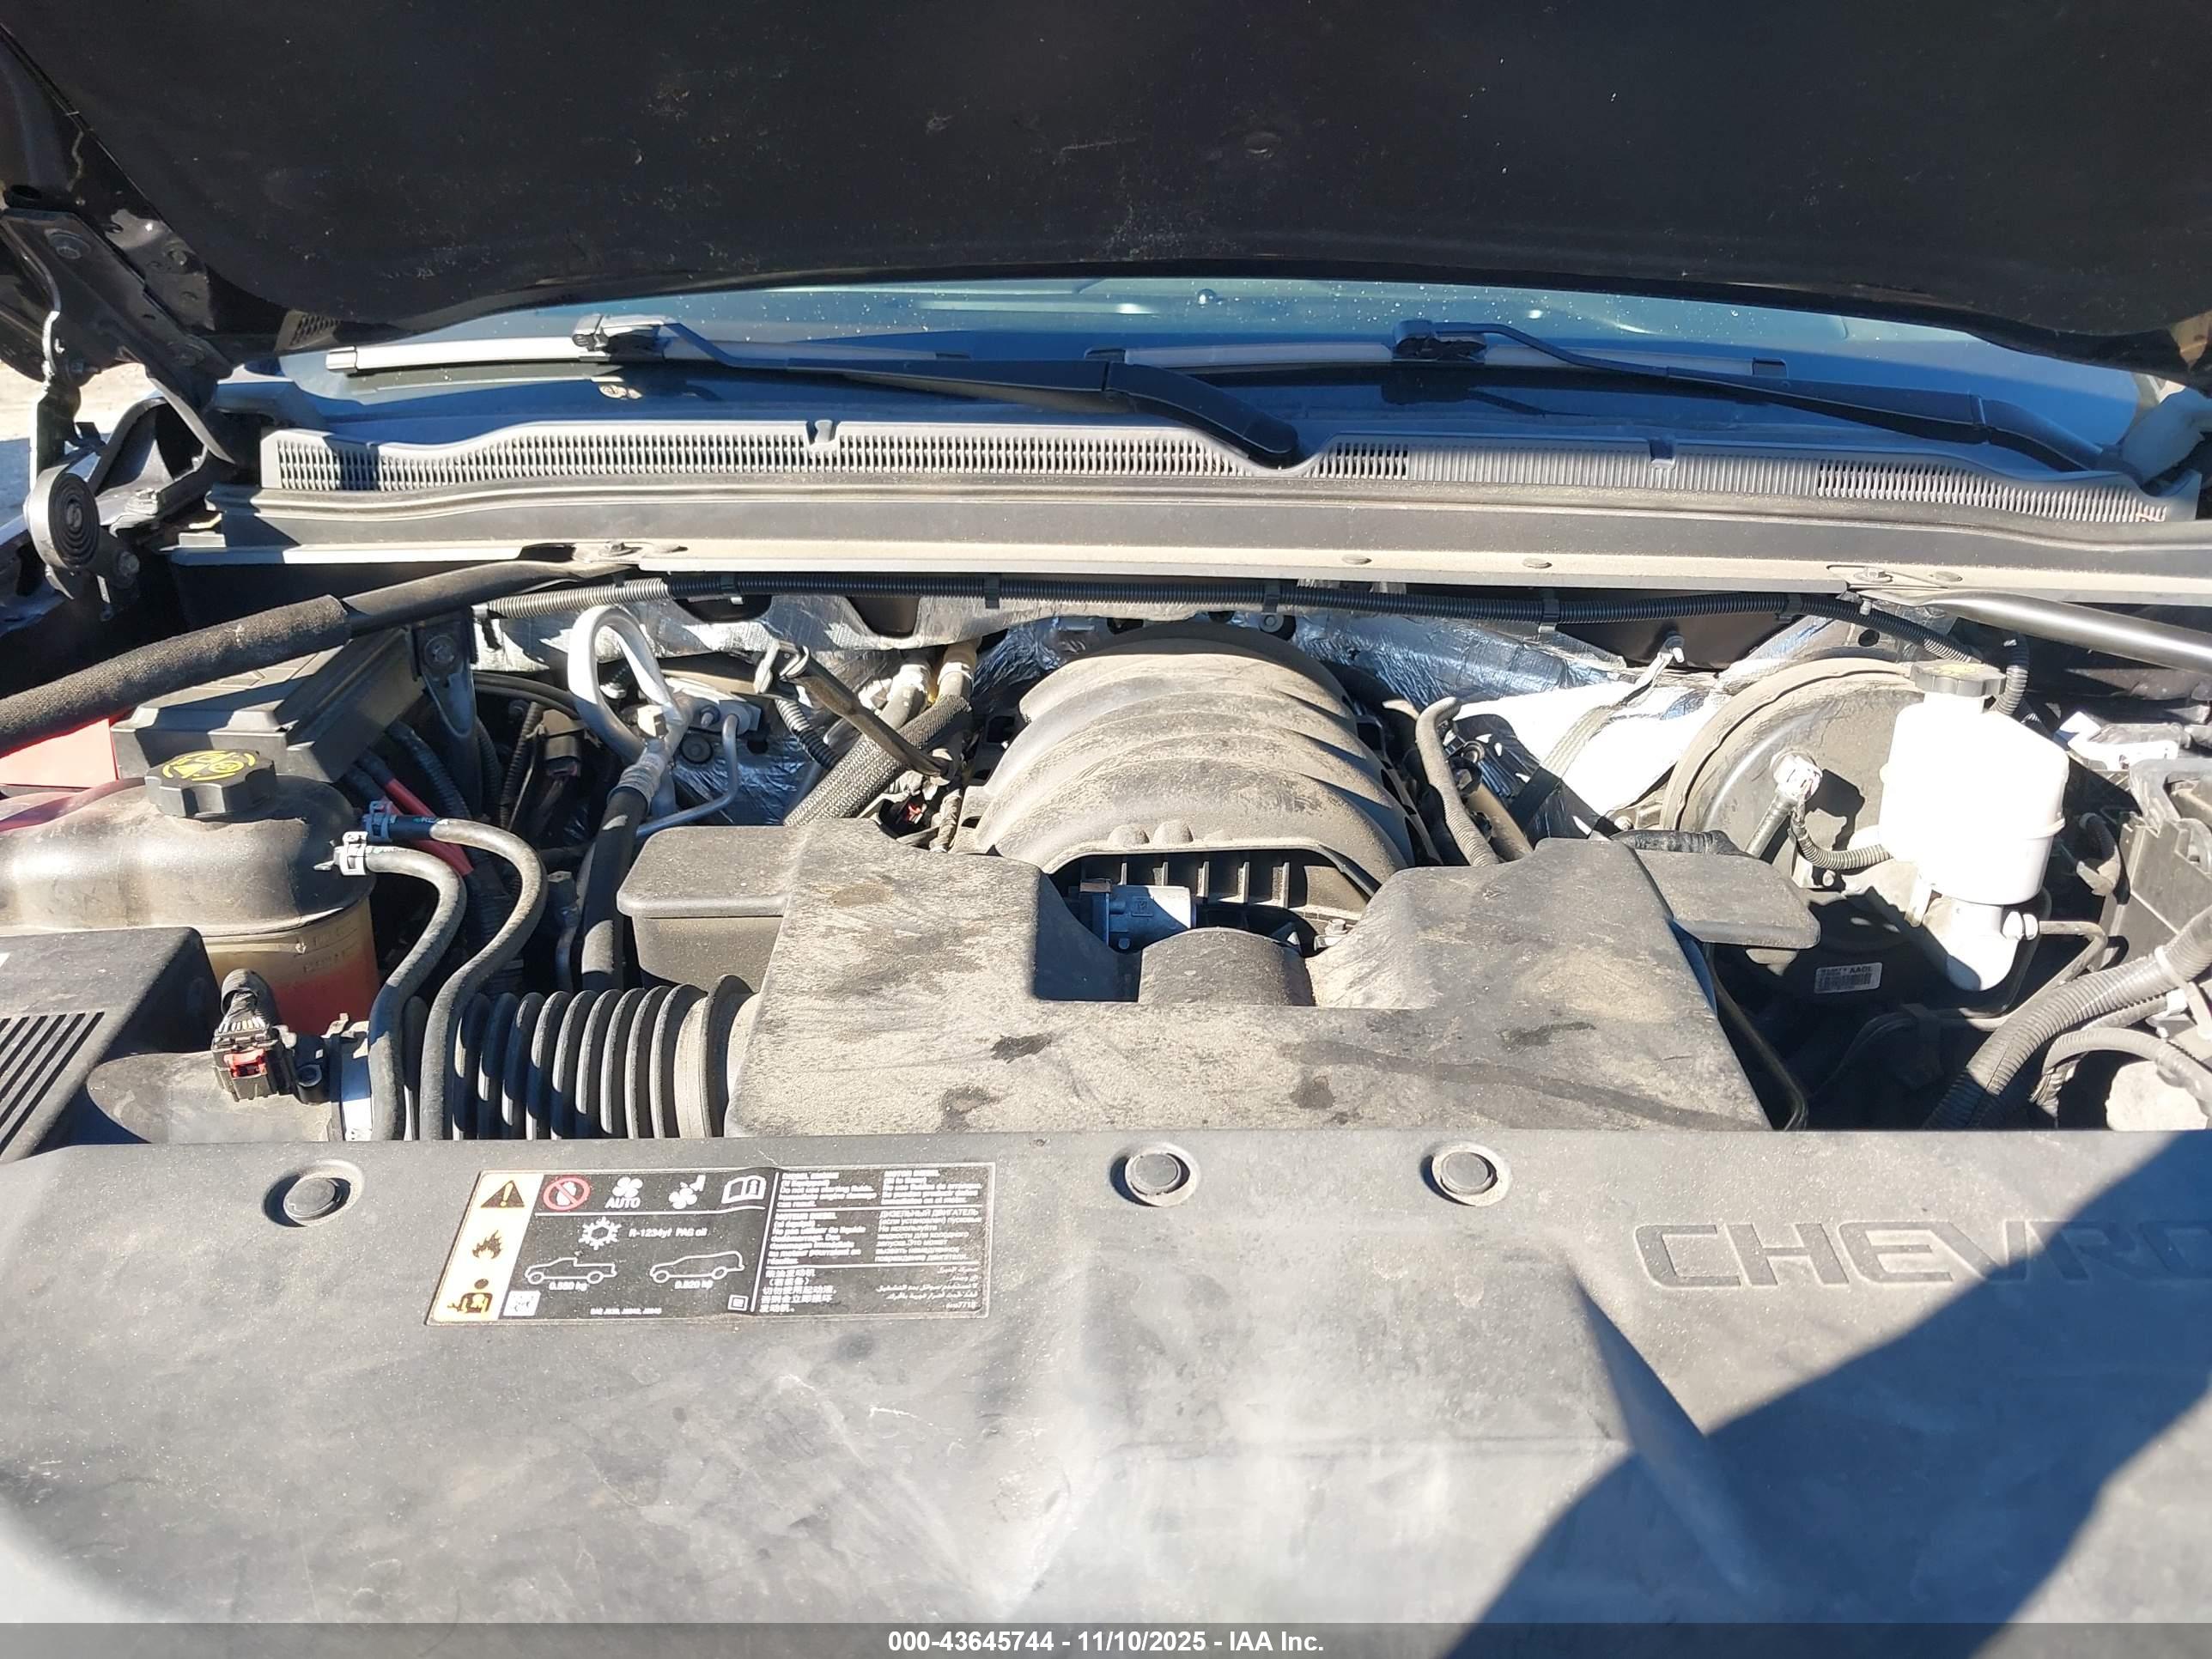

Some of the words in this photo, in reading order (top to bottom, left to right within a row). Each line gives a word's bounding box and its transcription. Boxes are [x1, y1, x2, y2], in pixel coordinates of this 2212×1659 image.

[605, 1197, 641, 1209] AUTO
[629, 1228, 672, 1238] R-1234yf
[695, 1228, 708, 1237] oil
